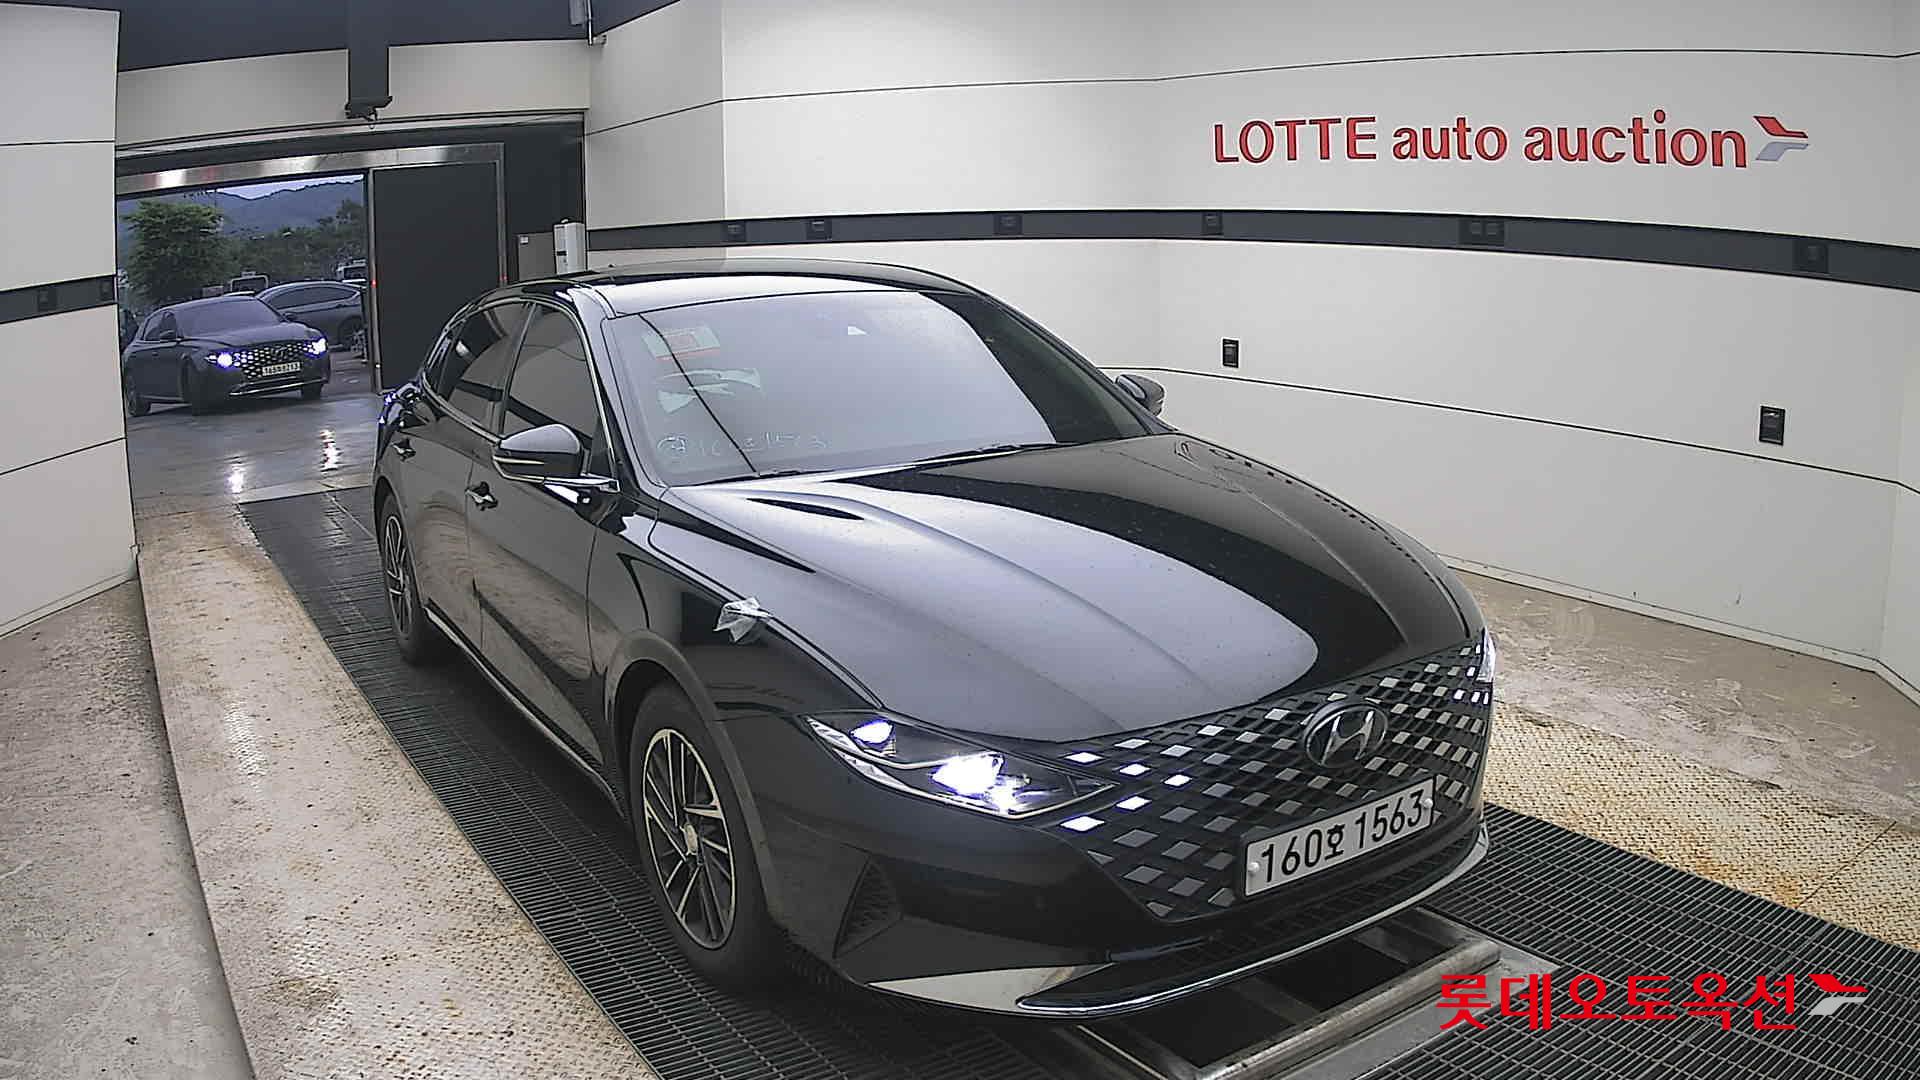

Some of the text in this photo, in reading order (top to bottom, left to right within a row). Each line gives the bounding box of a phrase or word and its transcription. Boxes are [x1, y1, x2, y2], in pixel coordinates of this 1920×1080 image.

[1213, 109, 1748, 169] LOTTE auto auction
[1261, 788, 1425, 883] 160호 1563
